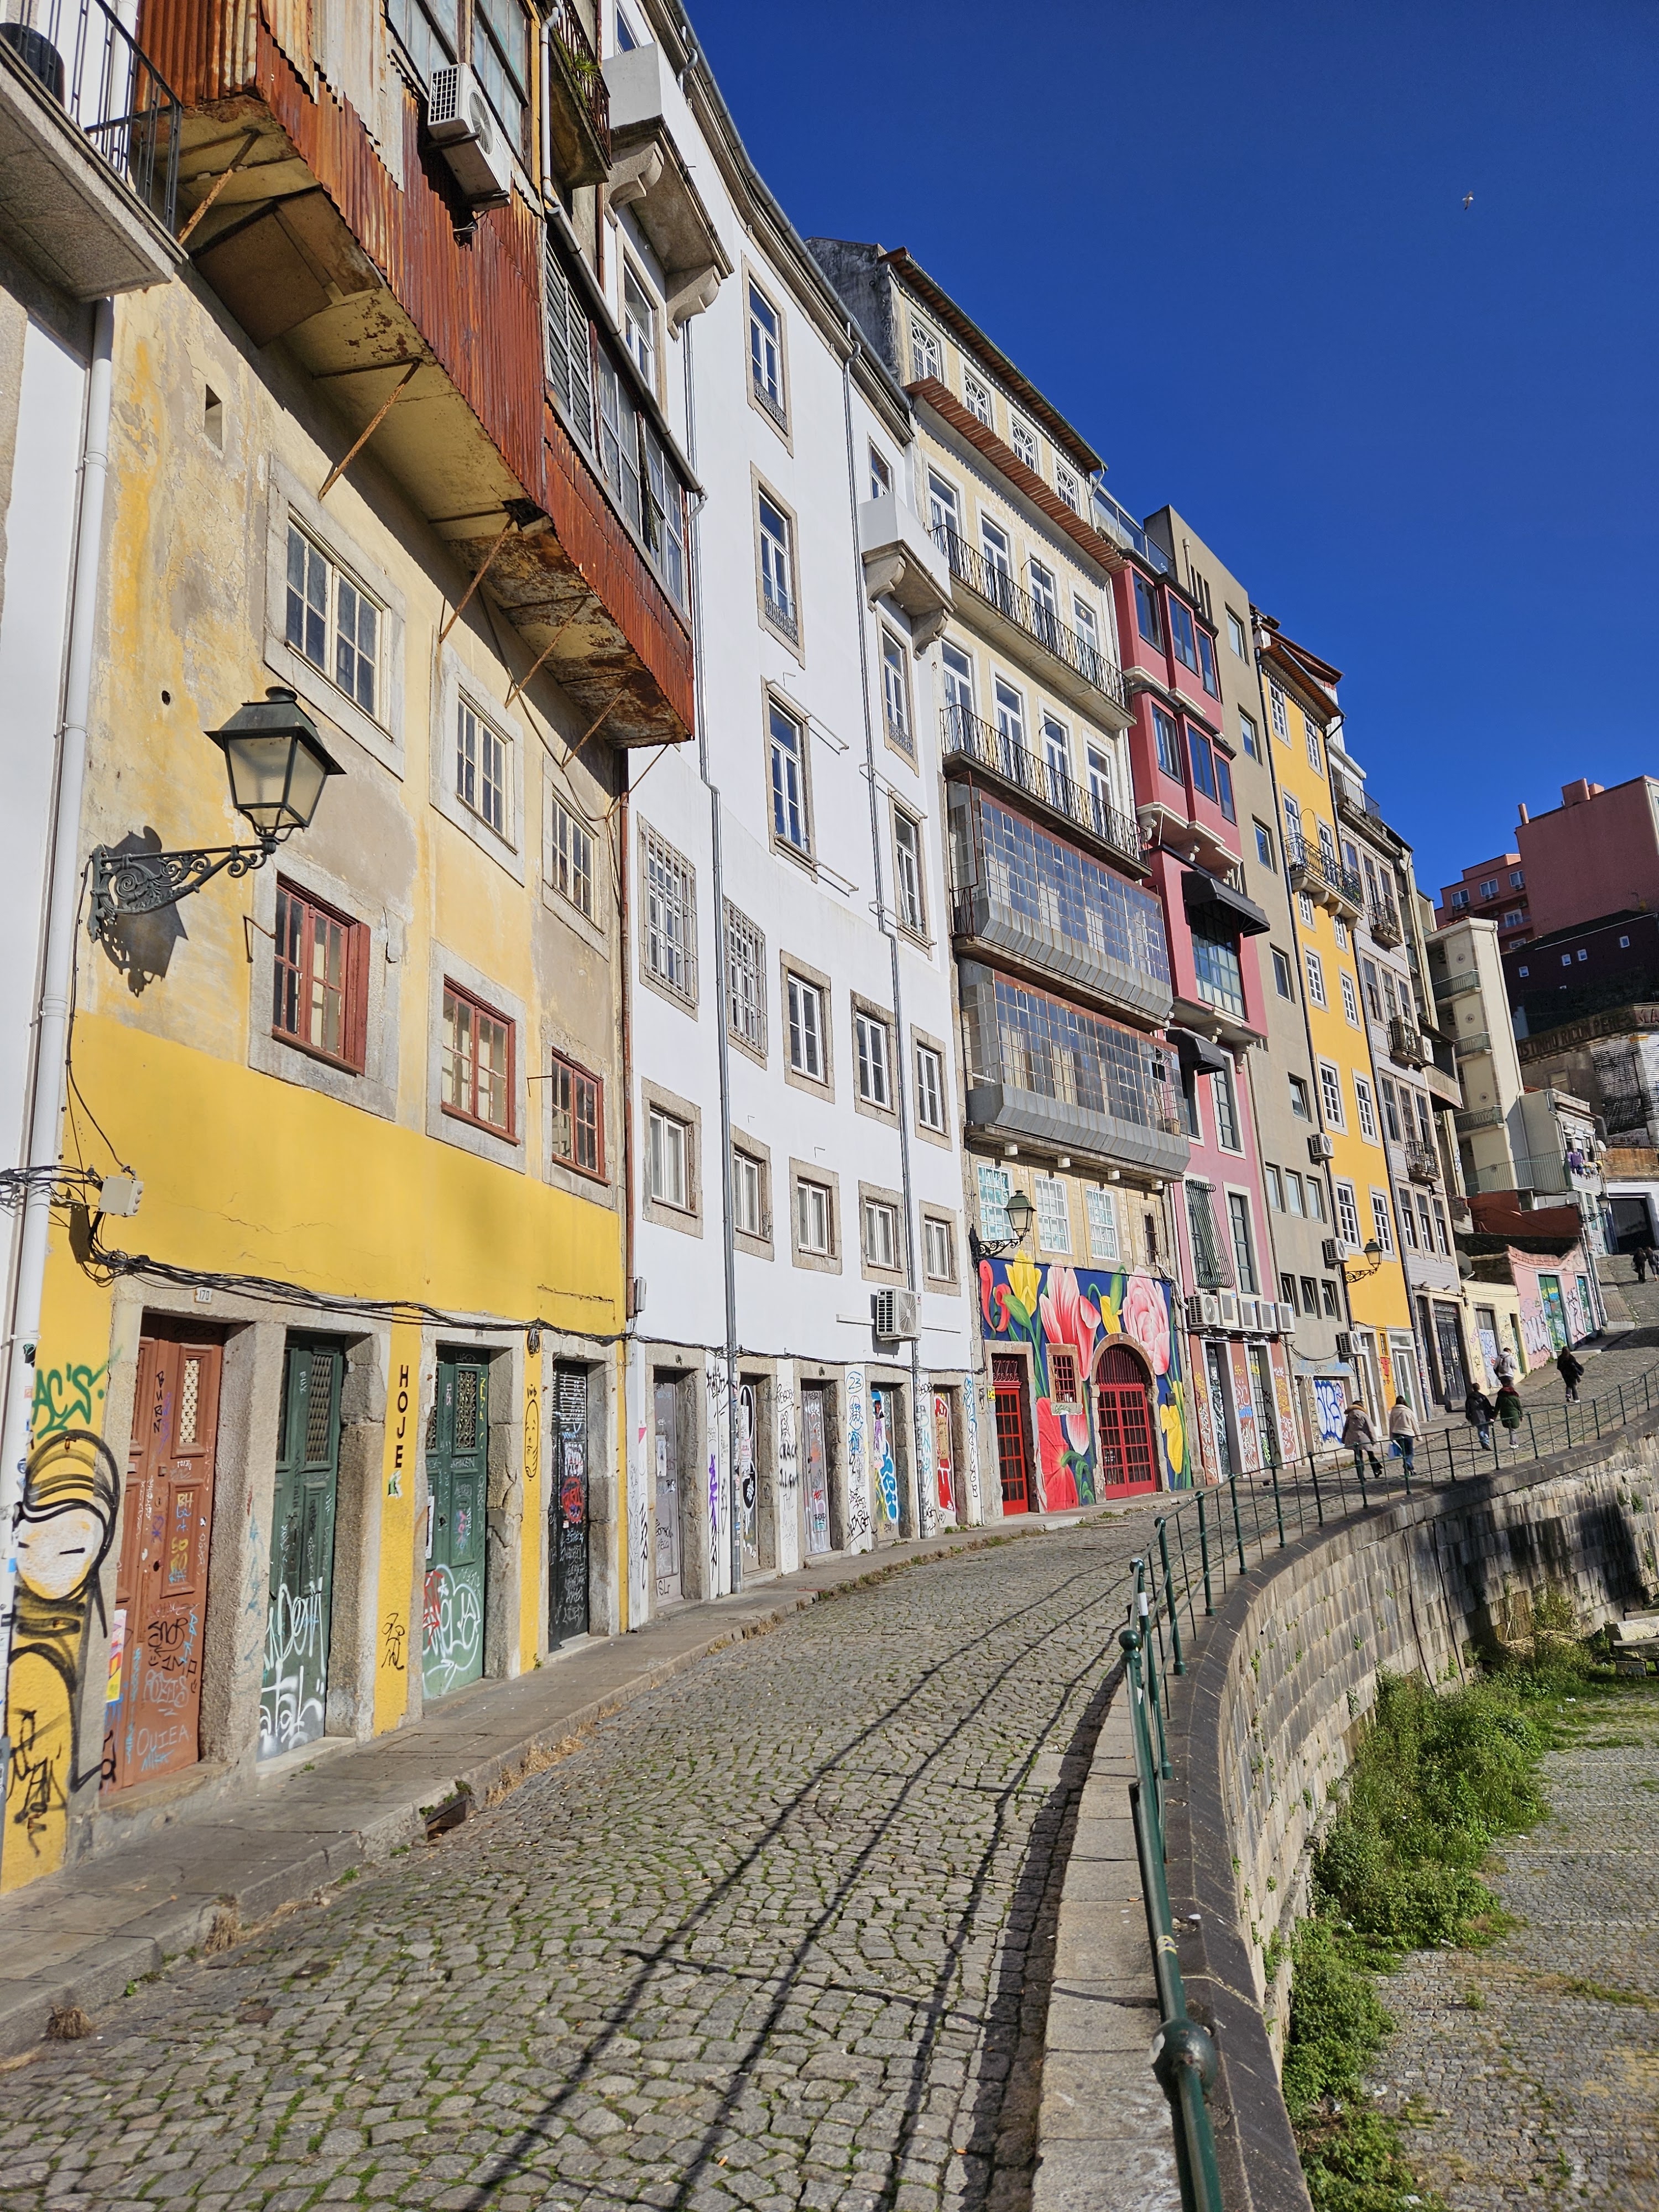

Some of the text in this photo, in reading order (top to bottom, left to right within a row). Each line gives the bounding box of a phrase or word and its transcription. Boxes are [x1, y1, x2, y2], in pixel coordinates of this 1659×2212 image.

[199, 1289, 210, 1301] 170
[848, 1376, 862, 1390] 23
[394, 1364, 409, 1469] HOJE
